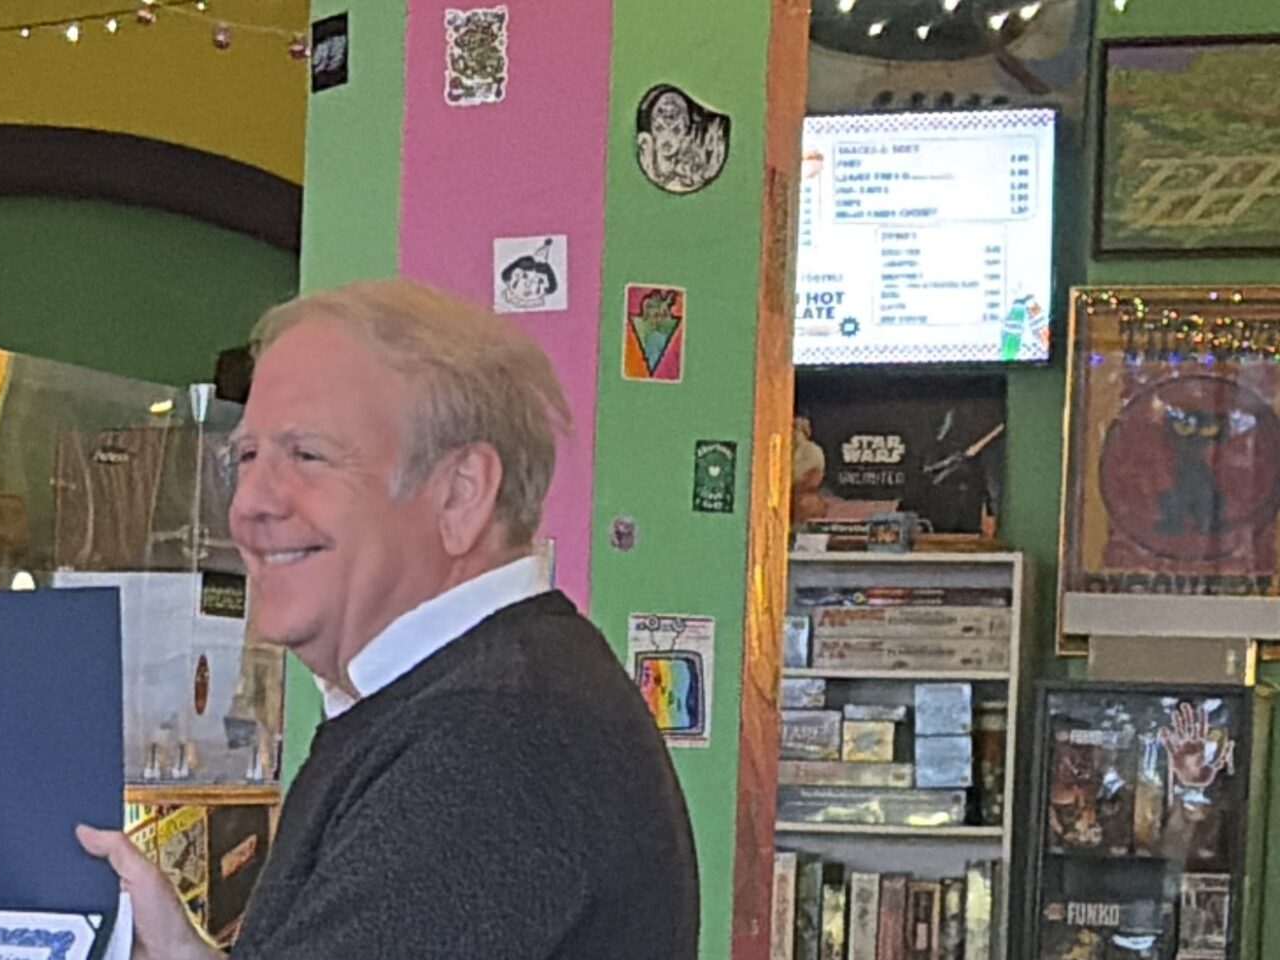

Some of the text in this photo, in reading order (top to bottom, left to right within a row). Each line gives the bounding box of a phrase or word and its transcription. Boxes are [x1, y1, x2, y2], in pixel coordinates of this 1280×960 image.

[806, 291, 846, 305] HOT
[842, 435, 904, 449] STAR
[843, 447, 905, 463] WARS
[838, 472, 906, 486] UNLIMITED
[1067, 902, 1120, 926] FUNKO
